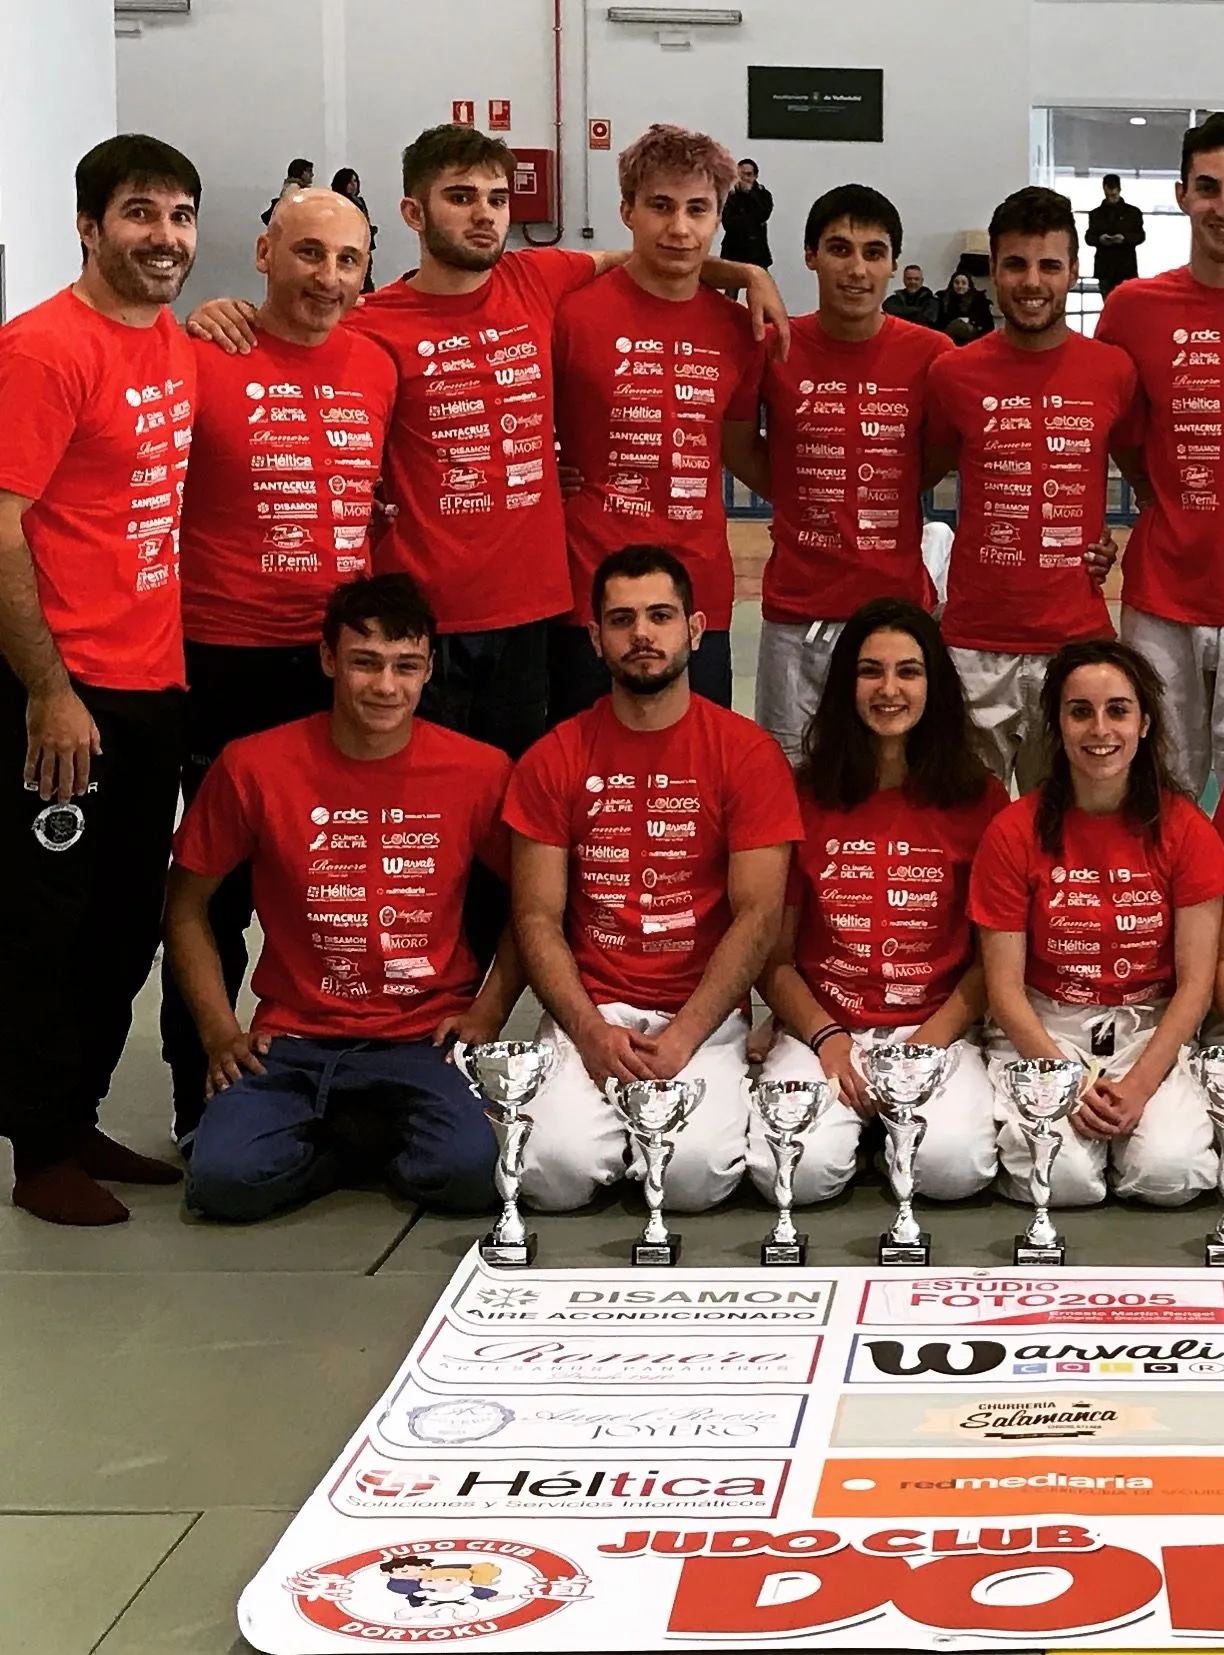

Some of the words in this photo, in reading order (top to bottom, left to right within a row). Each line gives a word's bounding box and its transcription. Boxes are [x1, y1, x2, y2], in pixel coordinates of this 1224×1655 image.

[1191, 329, 1221, 340] rdc
[438, 335, 471, 350] rdc
[635, 339, 664, 350] rdc
[269, 384, 302, 395] rdc
[817, 381, 847, 391] rdc
[440, 400, 484, 416] Héltica
[1001, 396, 1031, 407] rdc
[1183, 398, 1220, 410] Héltica
[623, 406, 661, 419] Héltica
[267, 454, 312, 467] Héltica
[333, 809, 368, 822] rdc
[842, 839, 875, 851] rdc
[1069, 870, 1100, 881] rdc
[321, 884, 365, 897] Héltica
[830, 914, 871, 928] Héltica
[1058, 939, 1100, 951] Héltica
[911, 1281, 1059, 1292] ESTUDIO
[569, 1291, 821, 1304] DISAMON
[910, 1293, 1176, 1307] FOTO2005
[466, 1309, 538, 1320] AIRE
[550, 1312, 815, 1320] ACONDICIONADO
[959, 1409, 1118, 1429] Salamanca
[591, 1424, 758, 1439] JOYERO
[457, 1470, 766, 1497] Héltica
[506, 1499, 612, 1508] Servicios
[597, 1529, 839, 1553] JUDO
[864, 1526, 1096, 1552] CLUB
[377, 1540, 456, 1561] JUDO
[466, 1540, 537, 1559] CLUB
[338, 1620, 499, 1640] DORYOKU
